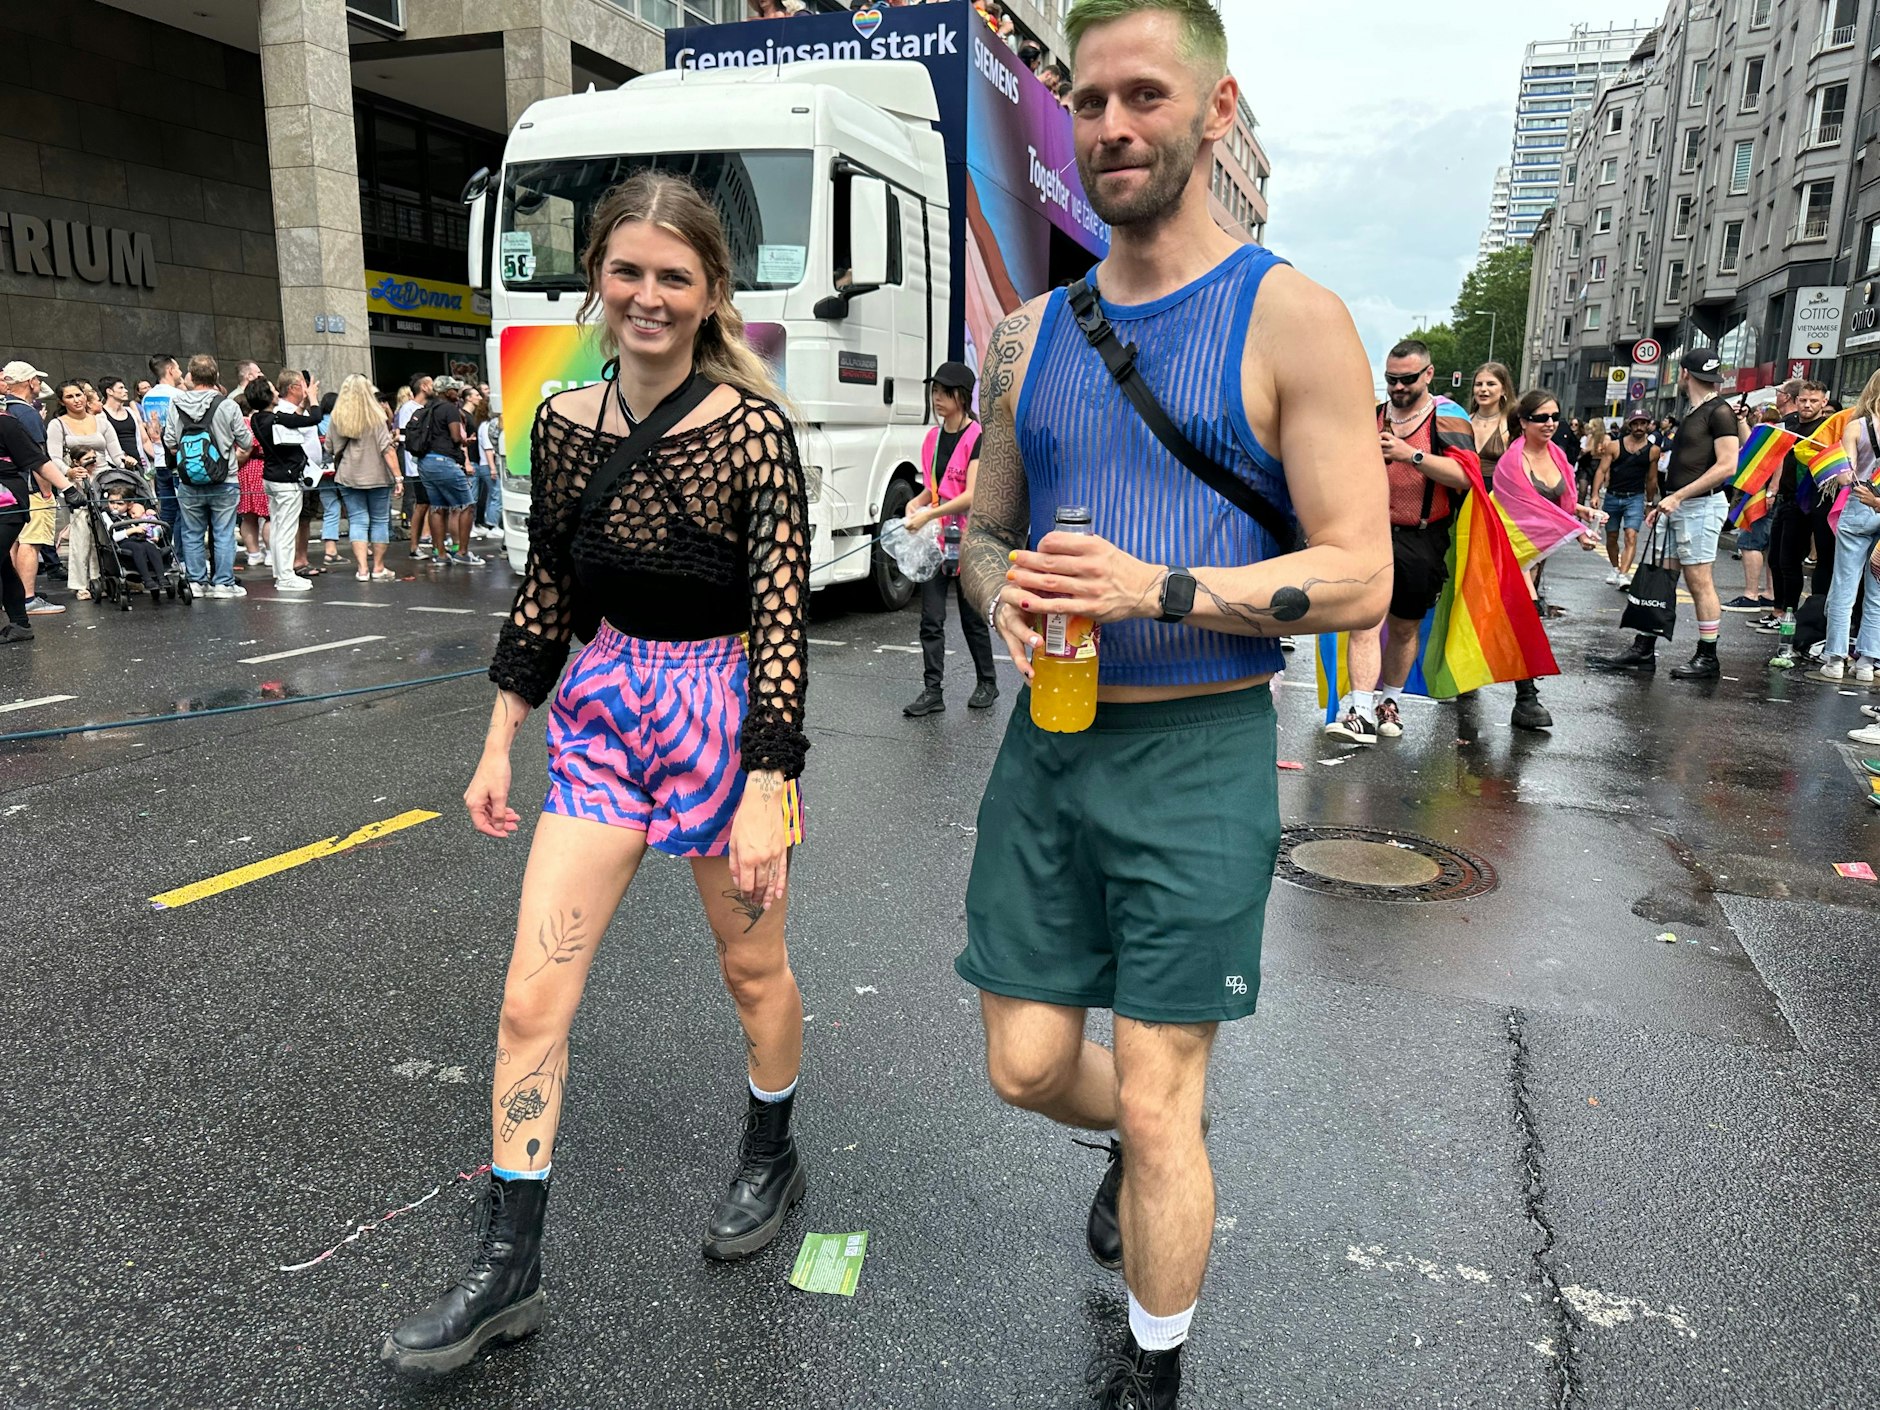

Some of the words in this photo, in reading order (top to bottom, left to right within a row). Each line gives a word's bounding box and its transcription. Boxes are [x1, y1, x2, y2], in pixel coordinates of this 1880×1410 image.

[675, 39, 862, 71] Gemeinsam
[871, 23, 957, 60] stark
[974, 36, 1019, 105] SIEMENS
[1027, 144, 1069, 213] Together
[1071, 193, 1082, 224] we
[1082, 200, 1098, 236] take
[1799, 307, 1840, 320] OTITO
[1851, 307, 1875, 331] OTITO
[1639, 346, 1655, 358] 30
[1641, 599, 1666, 608] TASCHE
